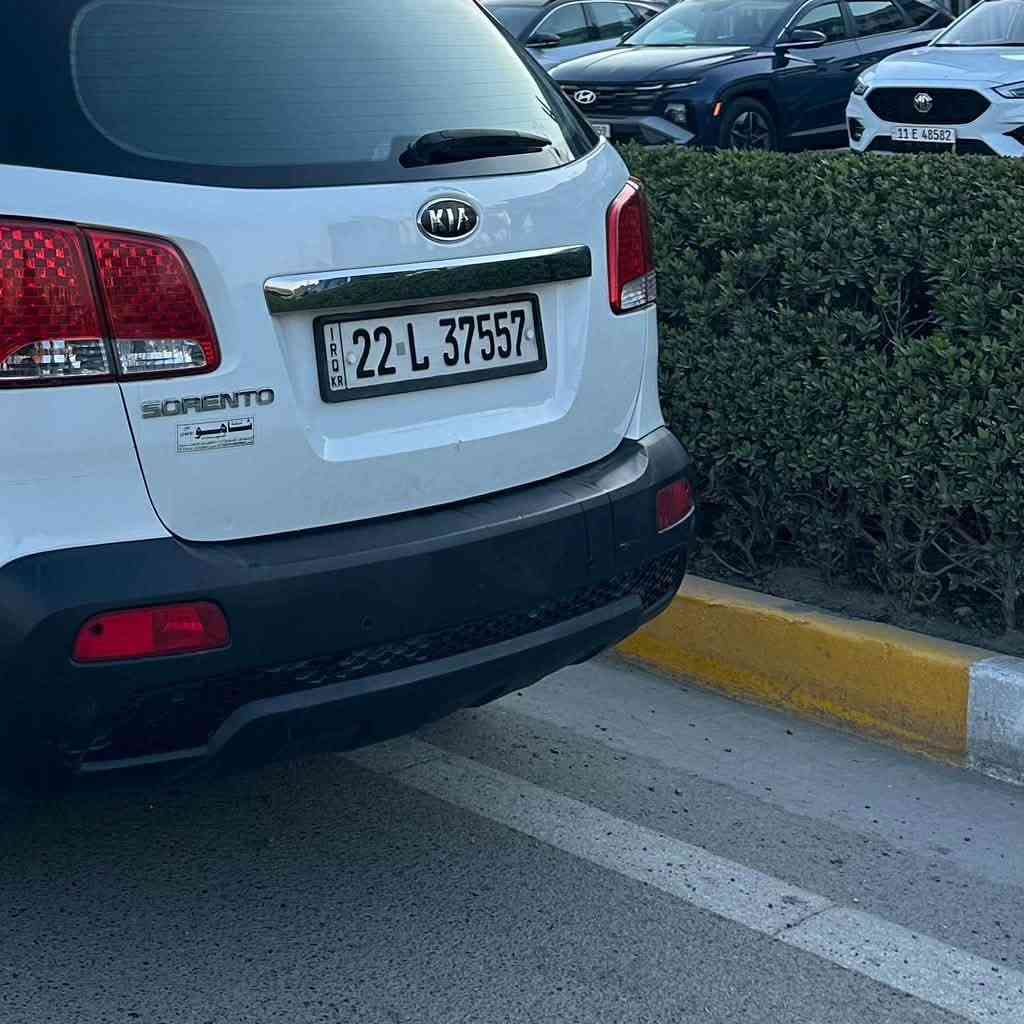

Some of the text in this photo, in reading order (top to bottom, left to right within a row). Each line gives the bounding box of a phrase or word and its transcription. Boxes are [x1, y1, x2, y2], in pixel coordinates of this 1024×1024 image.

[897, 128, 952, 141] 11 E 48582
[429, 207, 470, 233] KIA
[352, 309, 525, 379] 22 L 37557
[331, 376, 344, 388] KR
[142, 388, 275, 419] SORENTO
